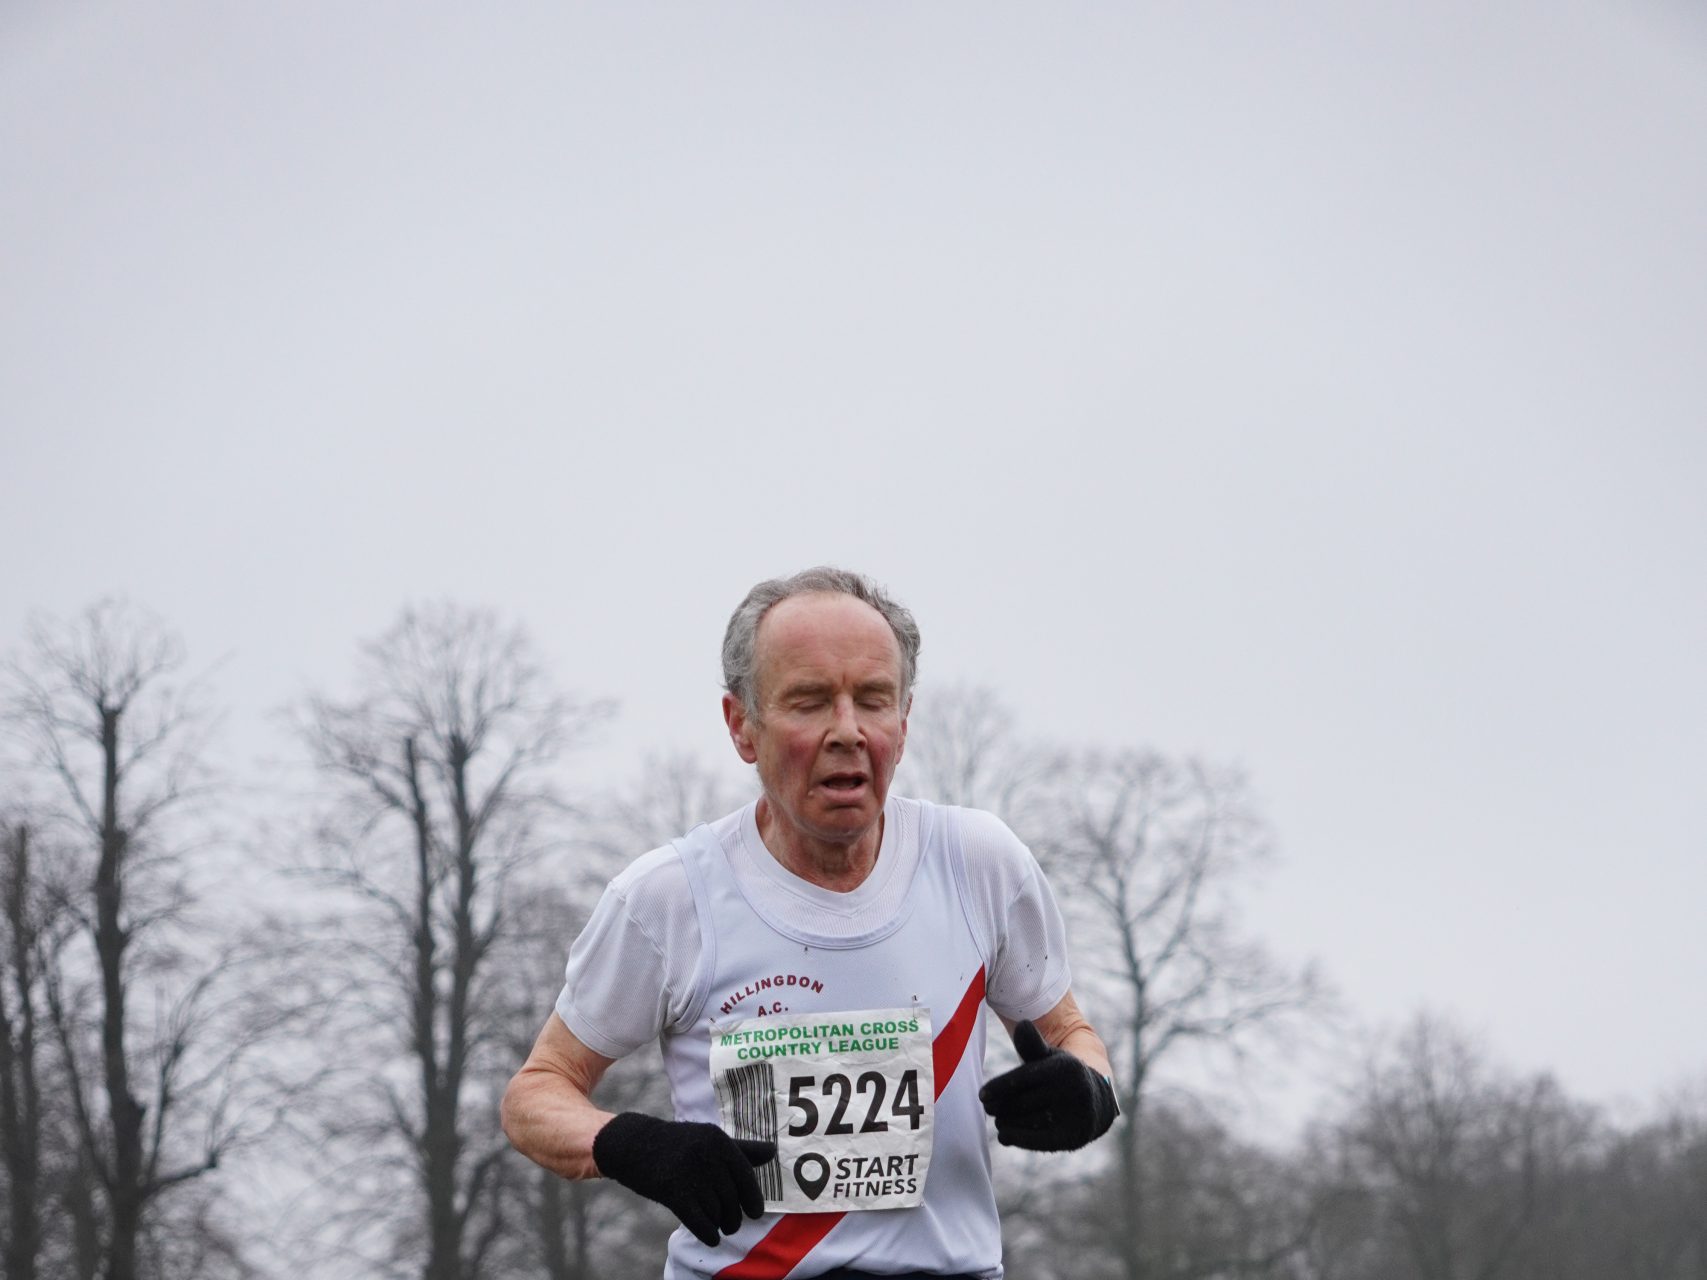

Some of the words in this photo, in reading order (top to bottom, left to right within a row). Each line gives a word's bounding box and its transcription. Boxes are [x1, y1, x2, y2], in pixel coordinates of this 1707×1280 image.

[720, 974, 824, 1015] HILLINGDON
[720, 1024, 854, 1047] METROPOLITAN
[860, 1020, 919, 1036] CROSS
[737, 1041, 822, 1060] COUNTRY
[828, 1037, 899, 1053] LEAGUE
[788, 1069, 925, 1137] 5224
[835, 1154, 919, 1180] START
[833, 1178, 917, 1198] FITNESS
